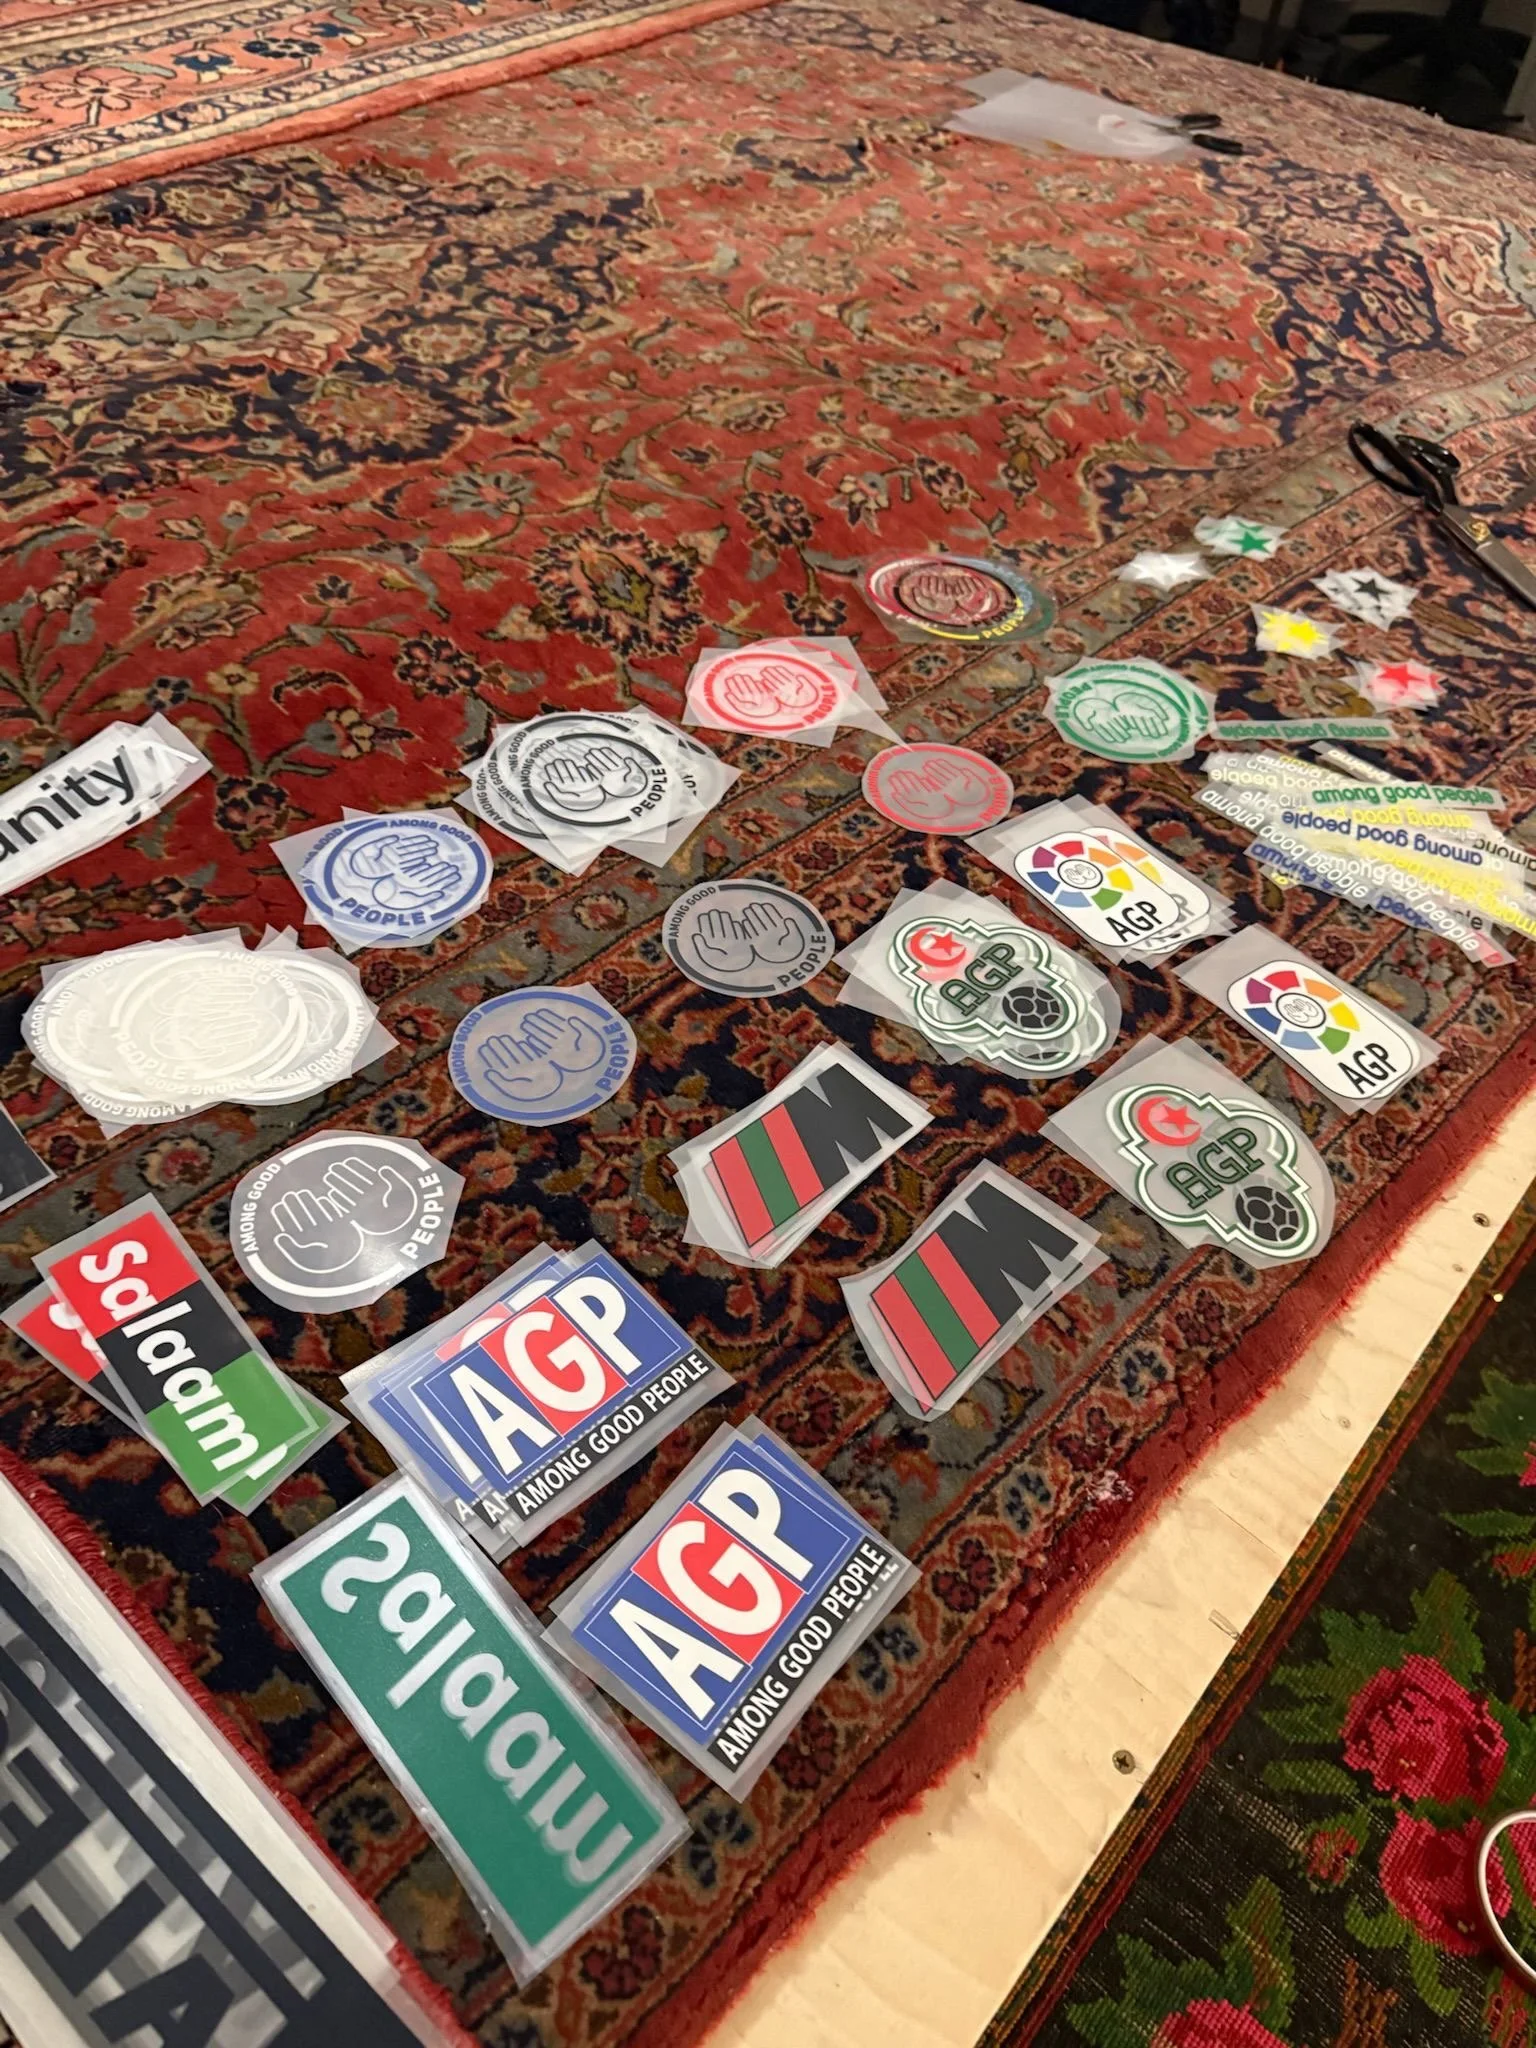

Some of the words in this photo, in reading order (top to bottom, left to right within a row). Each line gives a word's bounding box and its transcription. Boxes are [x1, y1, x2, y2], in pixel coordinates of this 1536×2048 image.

[520, 758, 536, 788] AMONG
[530, 739, 556, 758] GOOD
[630, 767, 668, 818] PEOPLE
[1312, 786, 1380, 804] among
[1382, 784, 1431, 803] good
[1433, 787, 1495, 806] people
[389, 819, 438, 829] AMONG
[477, 792, 505, 821] AMONG
[1282, 810, 1352, 836] people
[439, 824, 472, 843] GOOD
[1355, 823, 1409, 849] good
[1413, 833, 1483, 866] among
[340, 897, 426, 926] PEOPLE
[1106, 900, 1162, 943] AGP
[1415, 899, 1480, 950] people
[668, 905, 690, 938] AMONG
[687, 886, 717, 906] GOOD
[777, 935, 826, 988] PEOPLE
[940, 942, 1024, 1016] AGP
[456, 1012, 483, 1043] GOOD
[451, 1043, 472, 1084] AMONG
[595, 1021, 630, 1093] PEOPLE
[1338, 1043, 1398, 1095] AGP
[82, 1092, 124, 1115] GOOD
[126, 1103, 188, 1118] AMONG
[248, 1162, 282, 1202] GOOD
[1165, 1127, 1266, 1209] AGP
[239, 1203, 260, 1254] AMONG
[399, 1172, 445, 1260] PEOPLE
[450, 1276, 642, 1475] AGP
[515, 1446, 592, 1517] AMONG
[589, 1403, 646, 1456] GOOD
[643, 1353, 710, 1414] PEOPLE
[608, 1468, 814, 1721] AGP
[716, 1675, 790, 1766] AMONG
[778, 1614, 835, 1680] GOOD
[821, 1543, 887, 1620] PEOPLE
